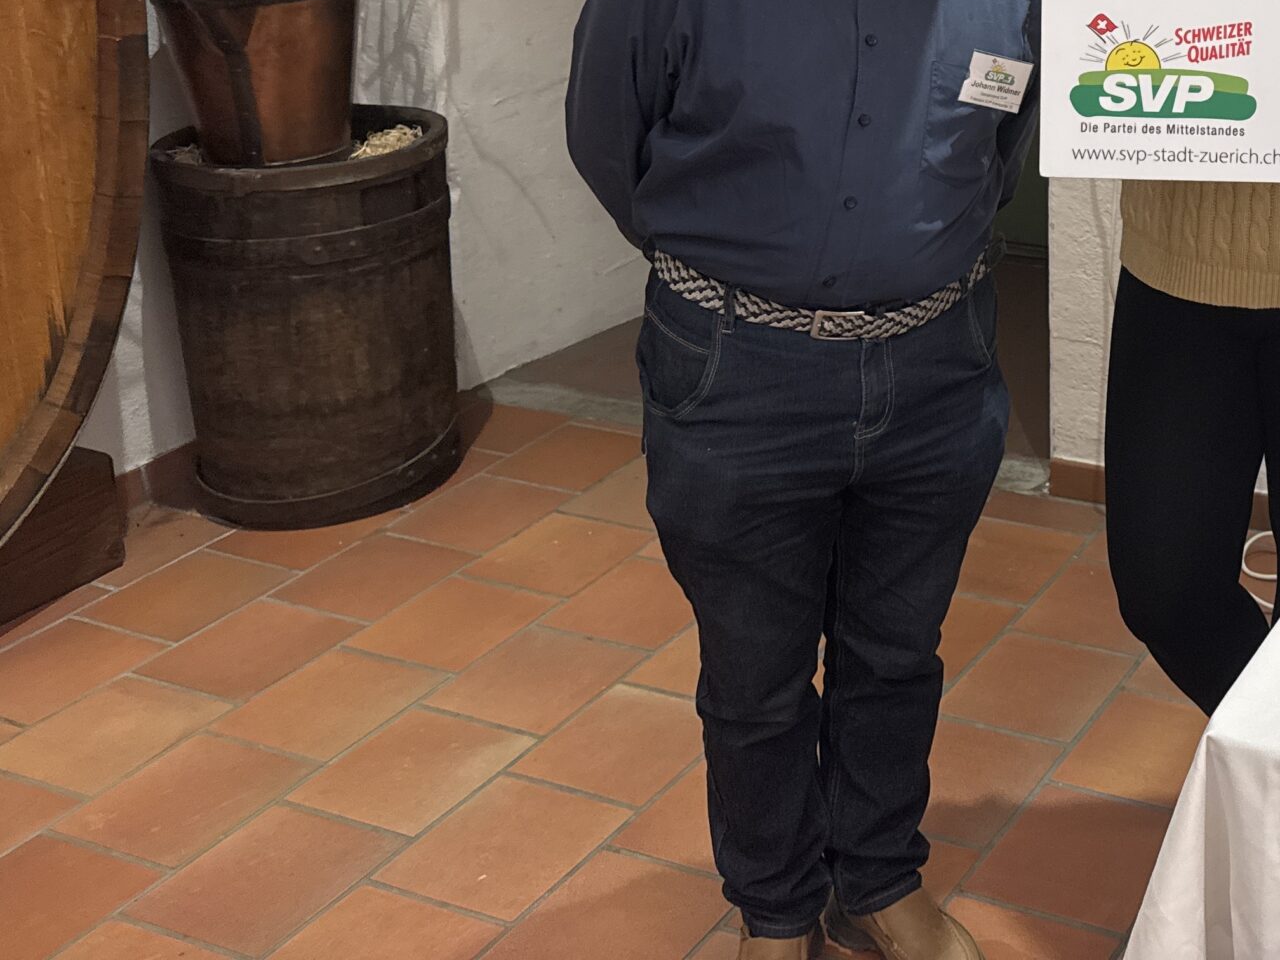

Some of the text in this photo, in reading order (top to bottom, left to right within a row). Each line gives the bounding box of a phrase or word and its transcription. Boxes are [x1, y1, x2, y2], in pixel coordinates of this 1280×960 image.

[1174, 21, 1253, 46] SCHWEIZER
[1187, 38, 1252, 64] QUALITÄT
[1098, 73, 1215, 113] SVP
[1080, 121, 1246, 137] Die Partei des Mittelstandes
